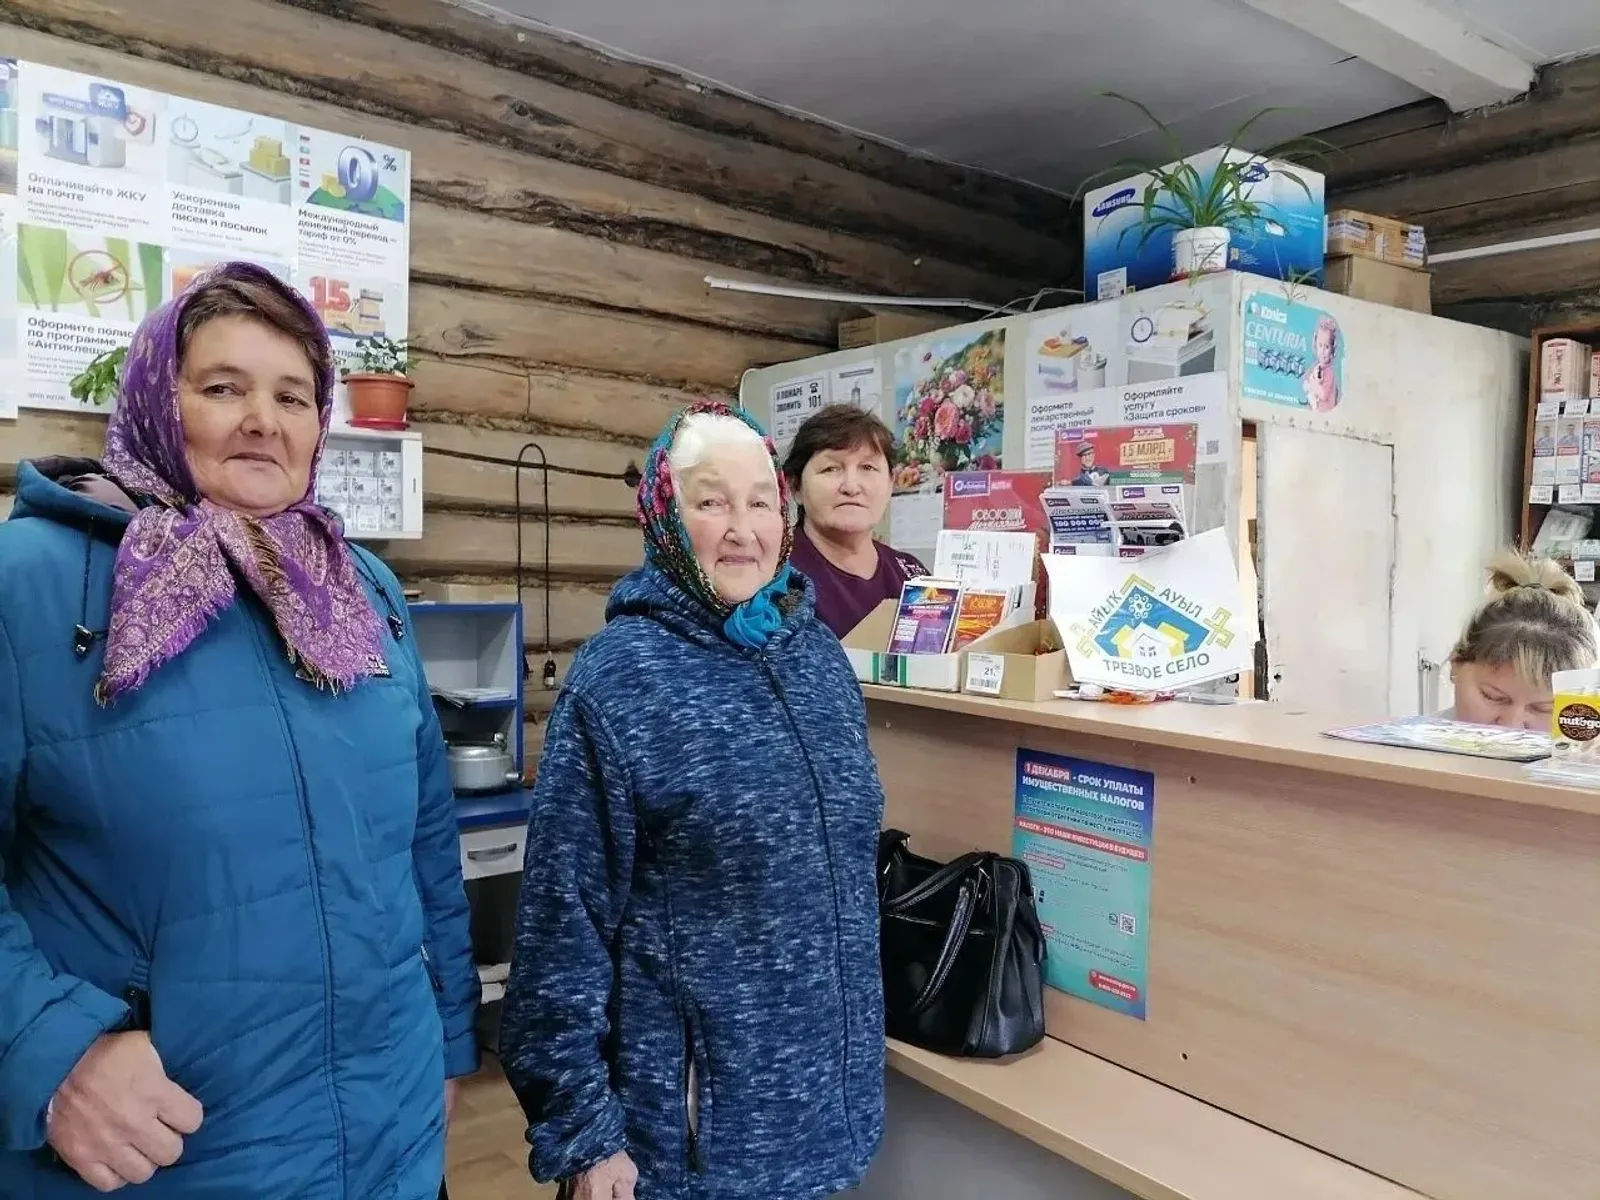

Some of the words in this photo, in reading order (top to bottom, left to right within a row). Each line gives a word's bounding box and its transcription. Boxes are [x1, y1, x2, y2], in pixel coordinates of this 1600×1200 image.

[28, 172, 113, 196] Оплачивайте
[116, 188, 147, 202] ЖКУ
[28, 185, 44, 195] на
[47, 188, 84, 201] почте
[171, 202, 226, 218] доставка
[172, 190, 241, 211] Ускоренная
[1096, 192, 1132, 212] SAMSUNG
[172, 212, 208, 225] писем
[210, 219, 218, 227] и
[220, 221, 268, 236] посылок
[298, 209, 379, 231] Международный
[298, 220, 348, 235] денежный
[350, 230, 389, 243] перевод
[298, 229, 329, 241] тариф
[28, 317, 95, 334] Оформите
[97, 327, 134, 338] полис
[28, 329, 44, 338] по
[47, 331, 117, 346] программе
[1246, 321, 1307, 352] CENTURIA
[808, 394, 821, 408] 101
[1123, 386, 1184, 402] Оформляйте
[1030, 407, 1095, 423] лекарственный
[1031, 401, 1073, 414] Оформите
[1123, 400, 1156, 413] услугу
[1123, 408, 1165, 422] «Защита
[1165, 404, 1206, 418] сроков»
[1030, 423, 1056, 433] полис
[1057, 421, 1067, 430] на
[1067, 418, 1092, 429] почте
[1159, 587, 1203, 618] АУЫЛ
[1103, 659, 1162, 680] ТРЕЗВОЕ
[1166, 653, 1210, 674] СЕЛО
[1031, 764, 1070, 780] ДЕКАБРЯ
[1078, 774, 1101, 787] СРОК
[1103, 778, 1144, 796] УПЛАТЫ
[1022, 776, 1099, 801] ИМУЩЕСТВЕННЫХ
[1100, 793, 1145, 811] НАЛОГОВ
